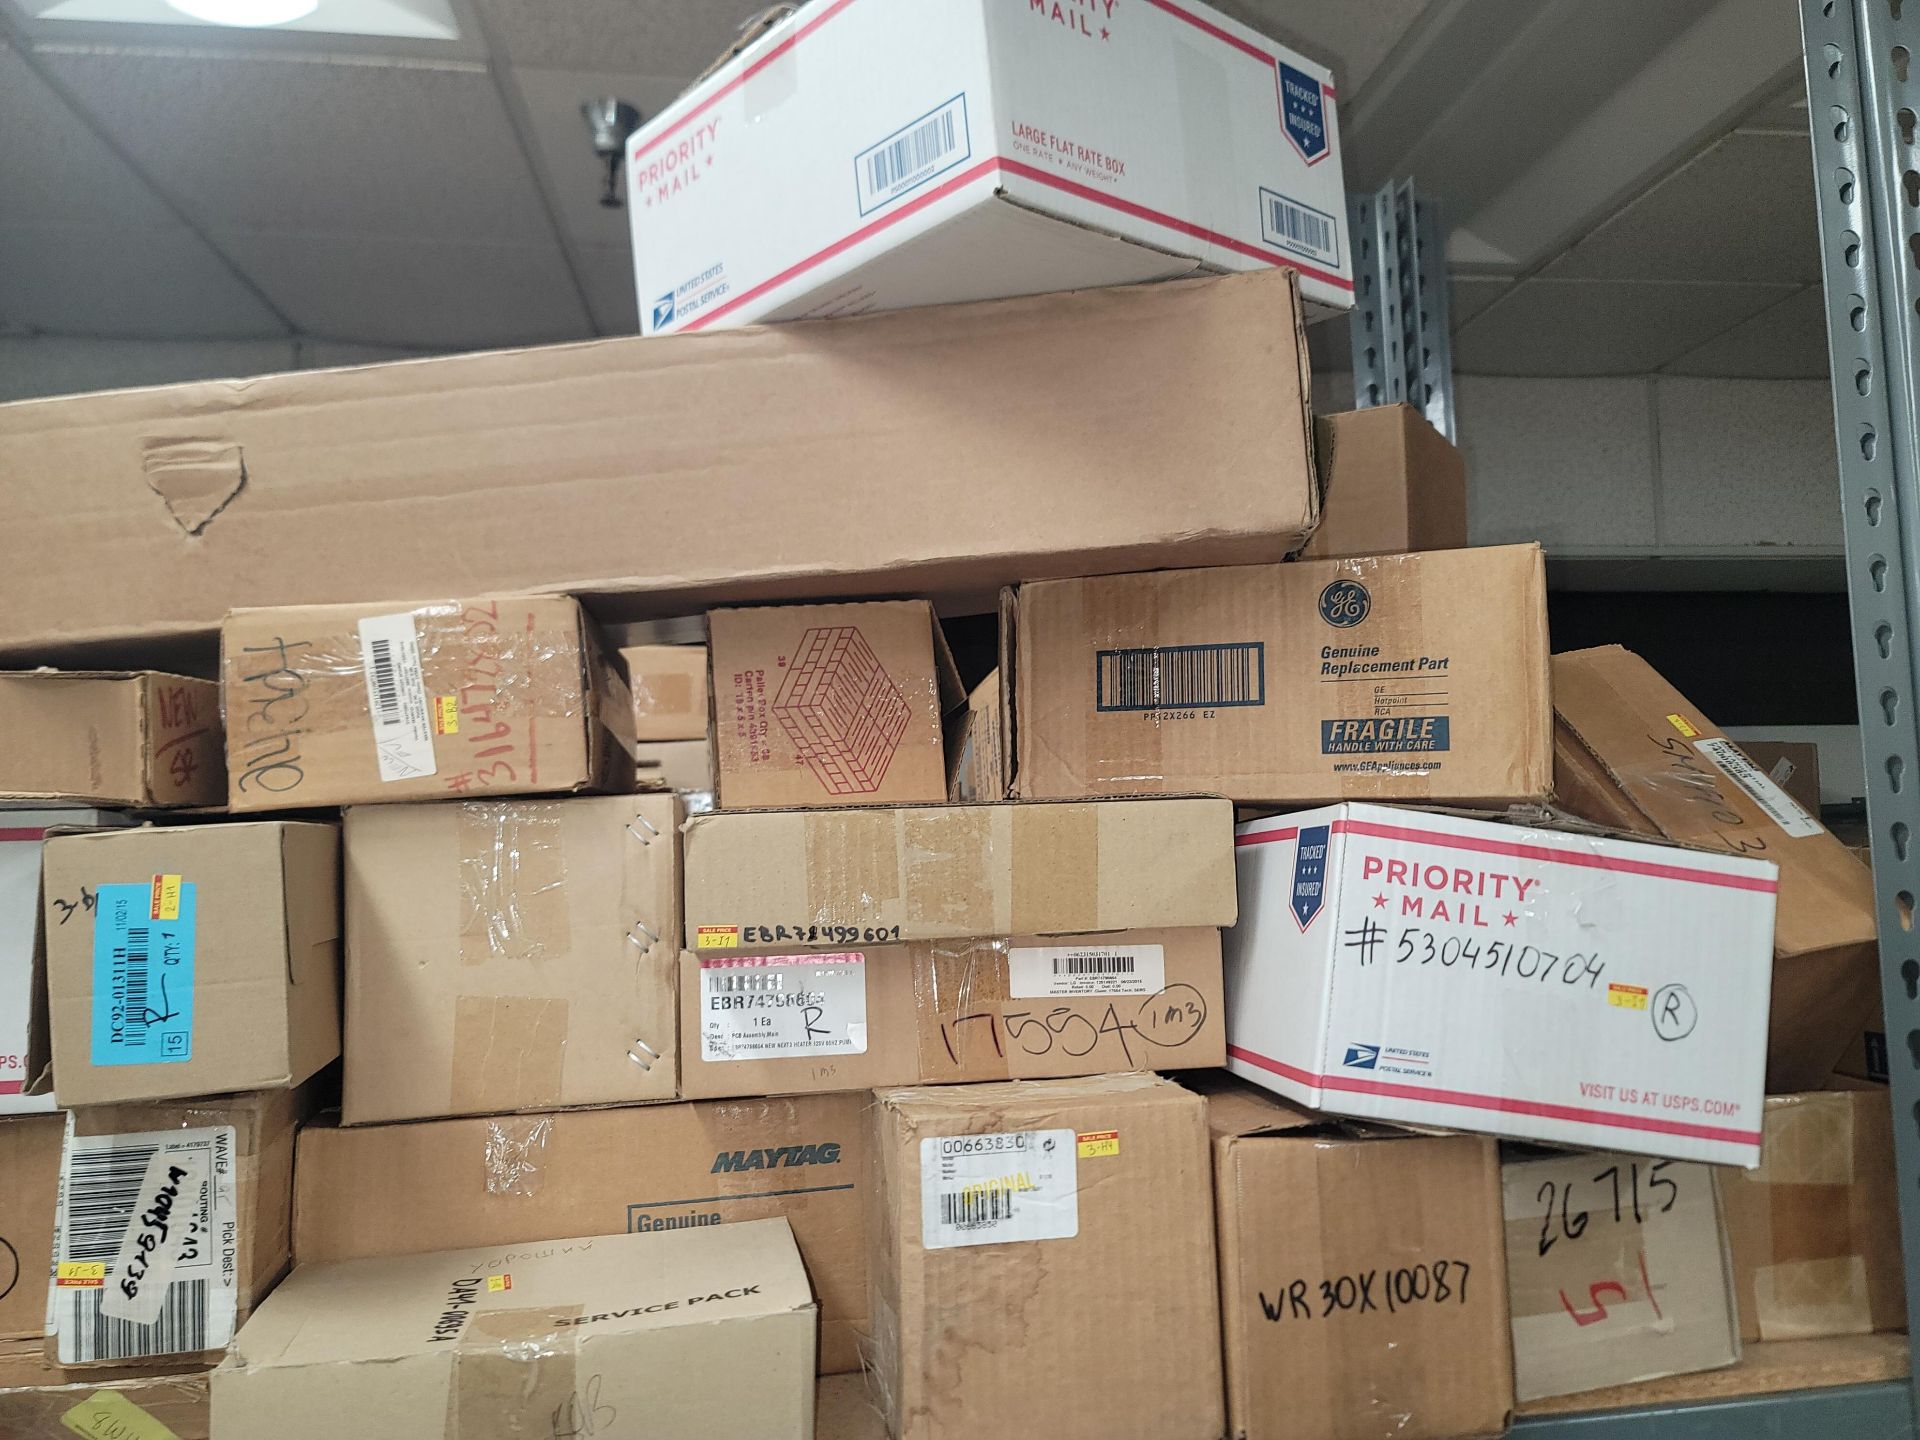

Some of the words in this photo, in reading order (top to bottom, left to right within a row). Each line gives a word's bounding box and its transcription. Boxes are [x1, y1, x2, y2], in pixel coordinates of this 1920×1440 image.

[638, 119, 718, 192] PRIORITY
[1012, 120, 1047, 147] LARGE
[1050, 135, 1074, 156] FLAT
[1077, 146, 1102, 168] RATE
[1105, 157, 1126, 176] BOX
[658, 165, 701, 203] MAIL
[676, 273, 699, 297] UNITED
[700, 262, 724, 284] STATES
[676, 299, 700, 321] POSTAL
[700, 283, 728, 307] SERVICE
[1321, 644, 1379, 659] Genuine
[1320, 658, 1415, 677] Replacement
[1418, 656, 1449, 671] Part
[1374, 686, 1386, 694] GE
[1374, 696, 1408, 705] Hotpoint
[1203, 711, 1216, 719] EZ
[1374, 708, 1391, 716] RCA
[1330, 718, 1437, 741] FRAGILE
[1328, 741, 1371, 752] HANDLE
[1374, 741, 1402, 751] WITH
[1406, 740, 1436, 750] CARE
[1301, 844, 1324, 860] TRACKED
[1296, 881, 1321, 896] INSURED
[1362, 856, 1535, 902] PRIORITY
[116, 899, 128, 931] 11/02/15
[1401, 895, 1489, 927] MAIL
[110, 947, 126, 1044] DC92-01311H
[762, 1016, 771, 1026] Ea
[800, 1006, 831, 1041] R
[167, 1034, 183, 1053] 15
[1580, 1082, 1615, 1100] VISIT
[1619, 1087, 1638, 1104] US
[1643, 1092, 1659, 1106] AT
[1664, 1095, 1738, 1117] USPS.COM
[215, 1133, 228, 1175] WAVE#
[223, 1221, 234, 1246] Pick
[637, 1210, 721, 1232] Genuine
[222, 1248, 234, 1278] Dest:
[553, 1301, 679, 1328] SERVICE
[687, 1284, 762, 1307] PACK
